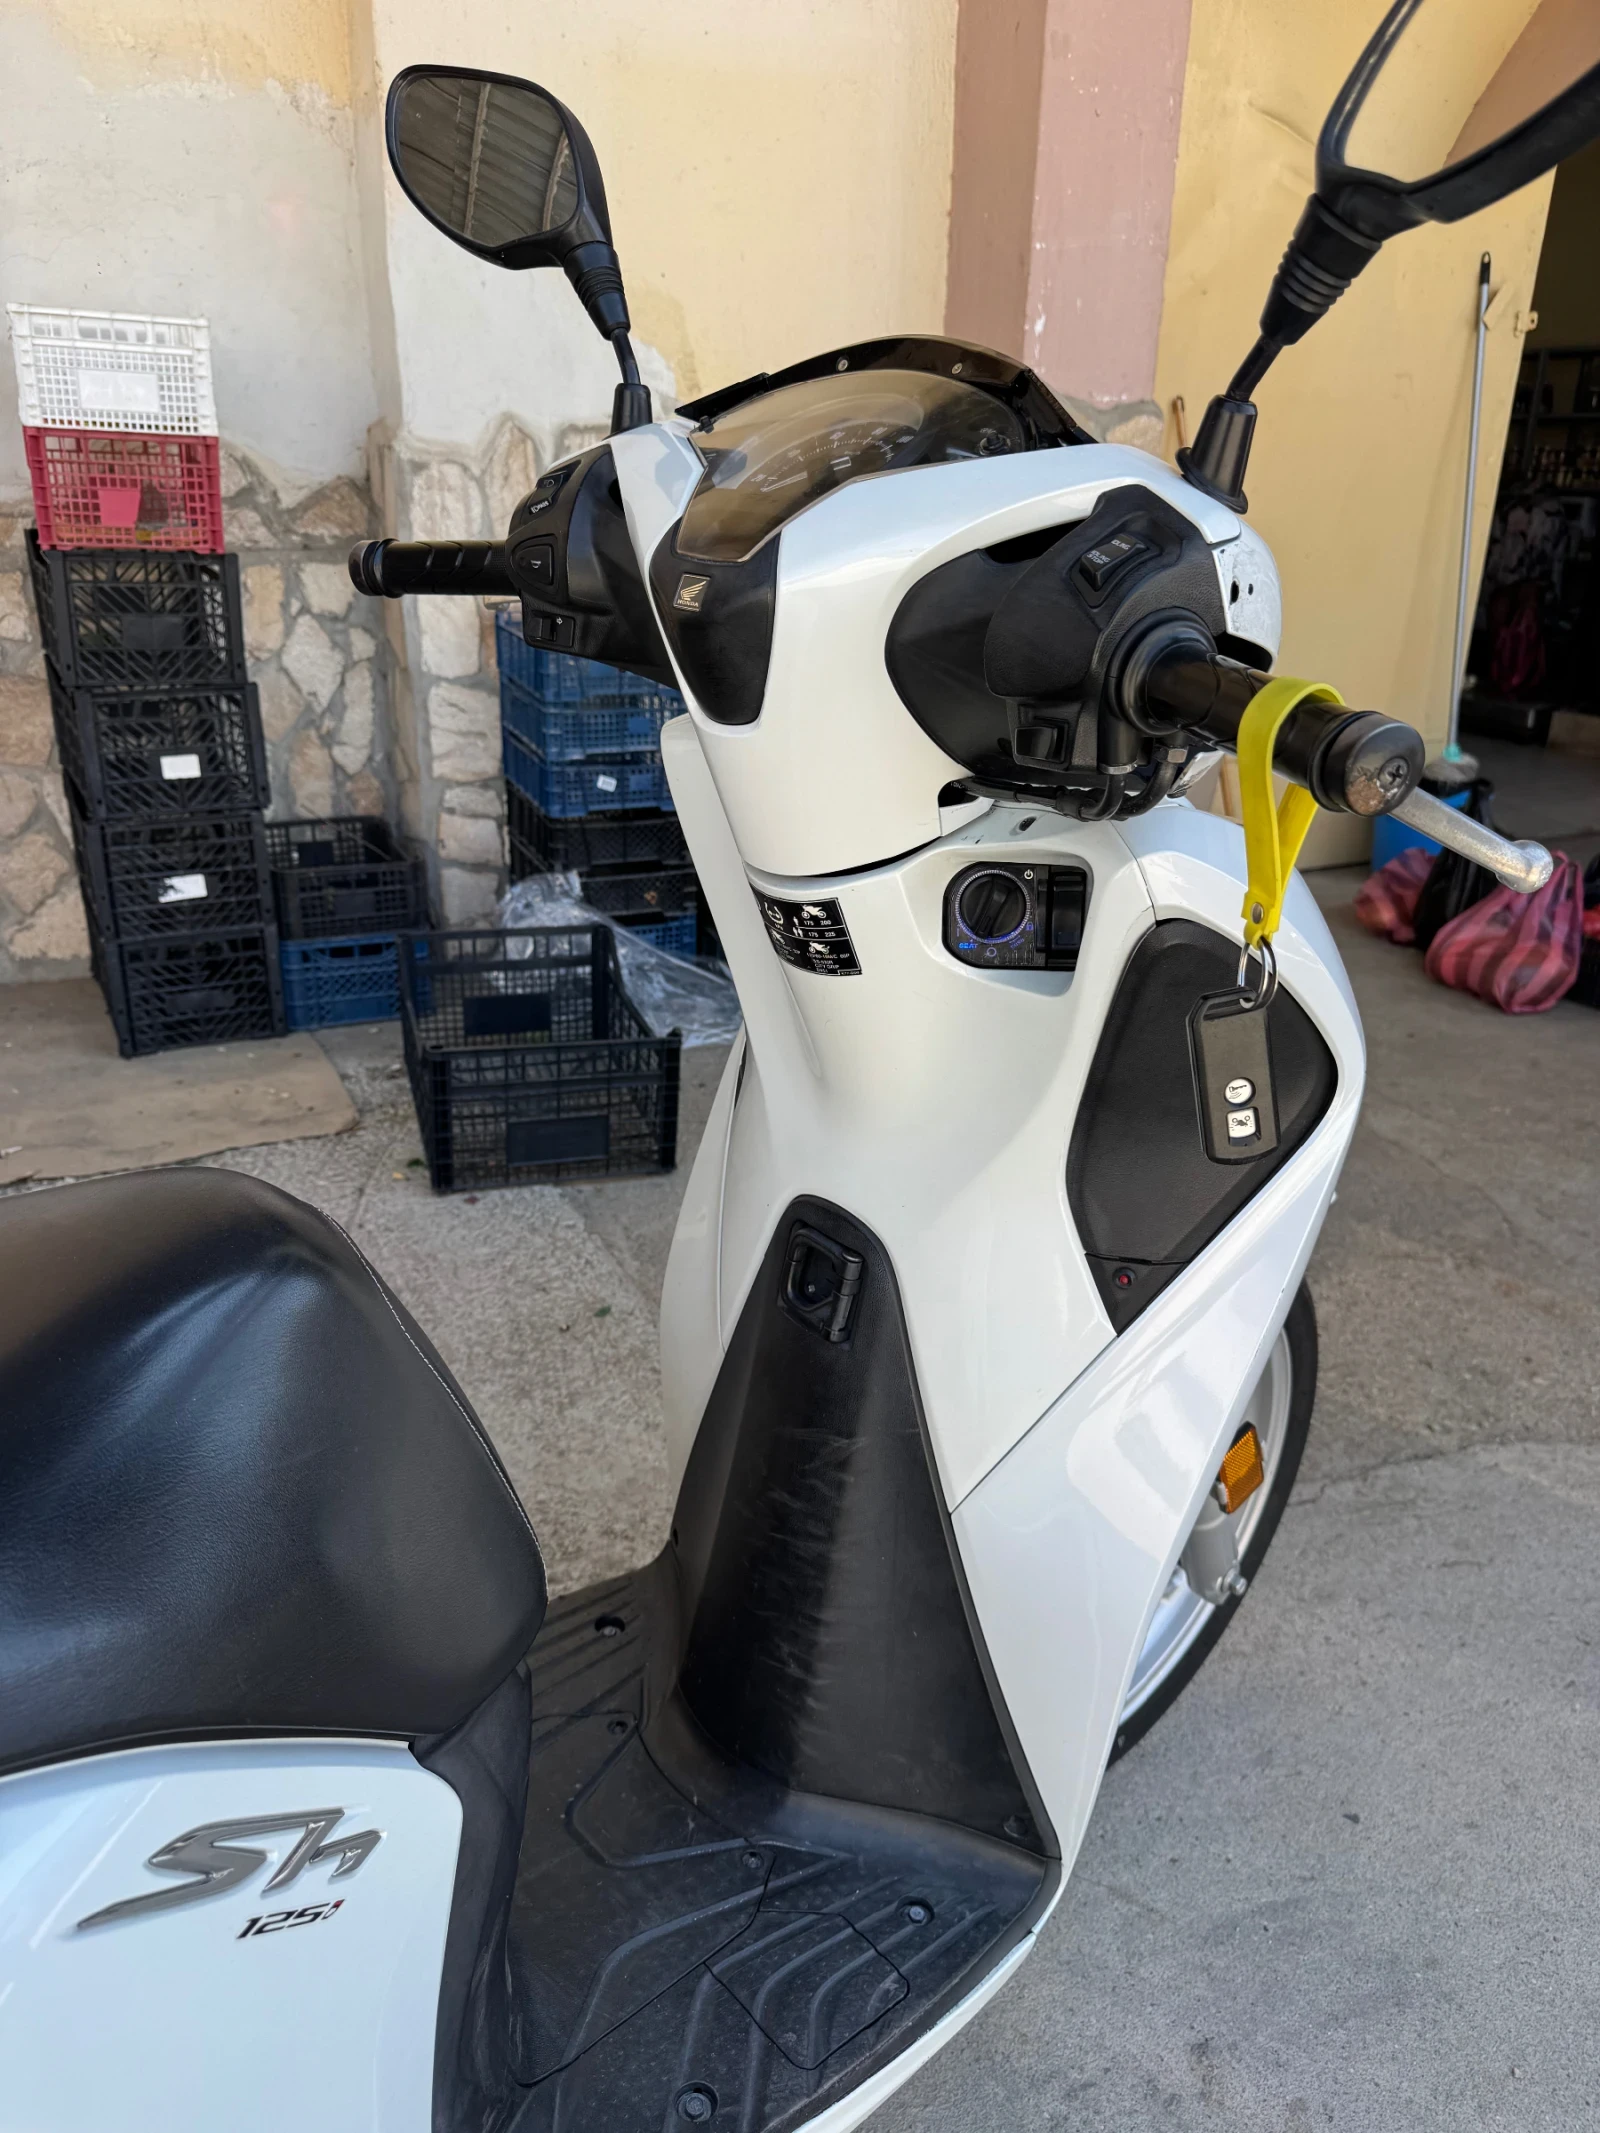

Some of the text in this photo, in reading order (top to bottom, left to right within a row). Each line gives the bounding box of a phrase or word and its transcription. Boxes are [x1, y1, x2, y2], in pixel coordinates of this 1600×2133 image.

[1110, 539, 1131, 550] IDLING
[1086, 553, 1104, 564] STOP
[677, 599, 699, 607] HONDA
[958, 942, 978, 950] SEAT
[235, 1898, 346, 1940] 125i
